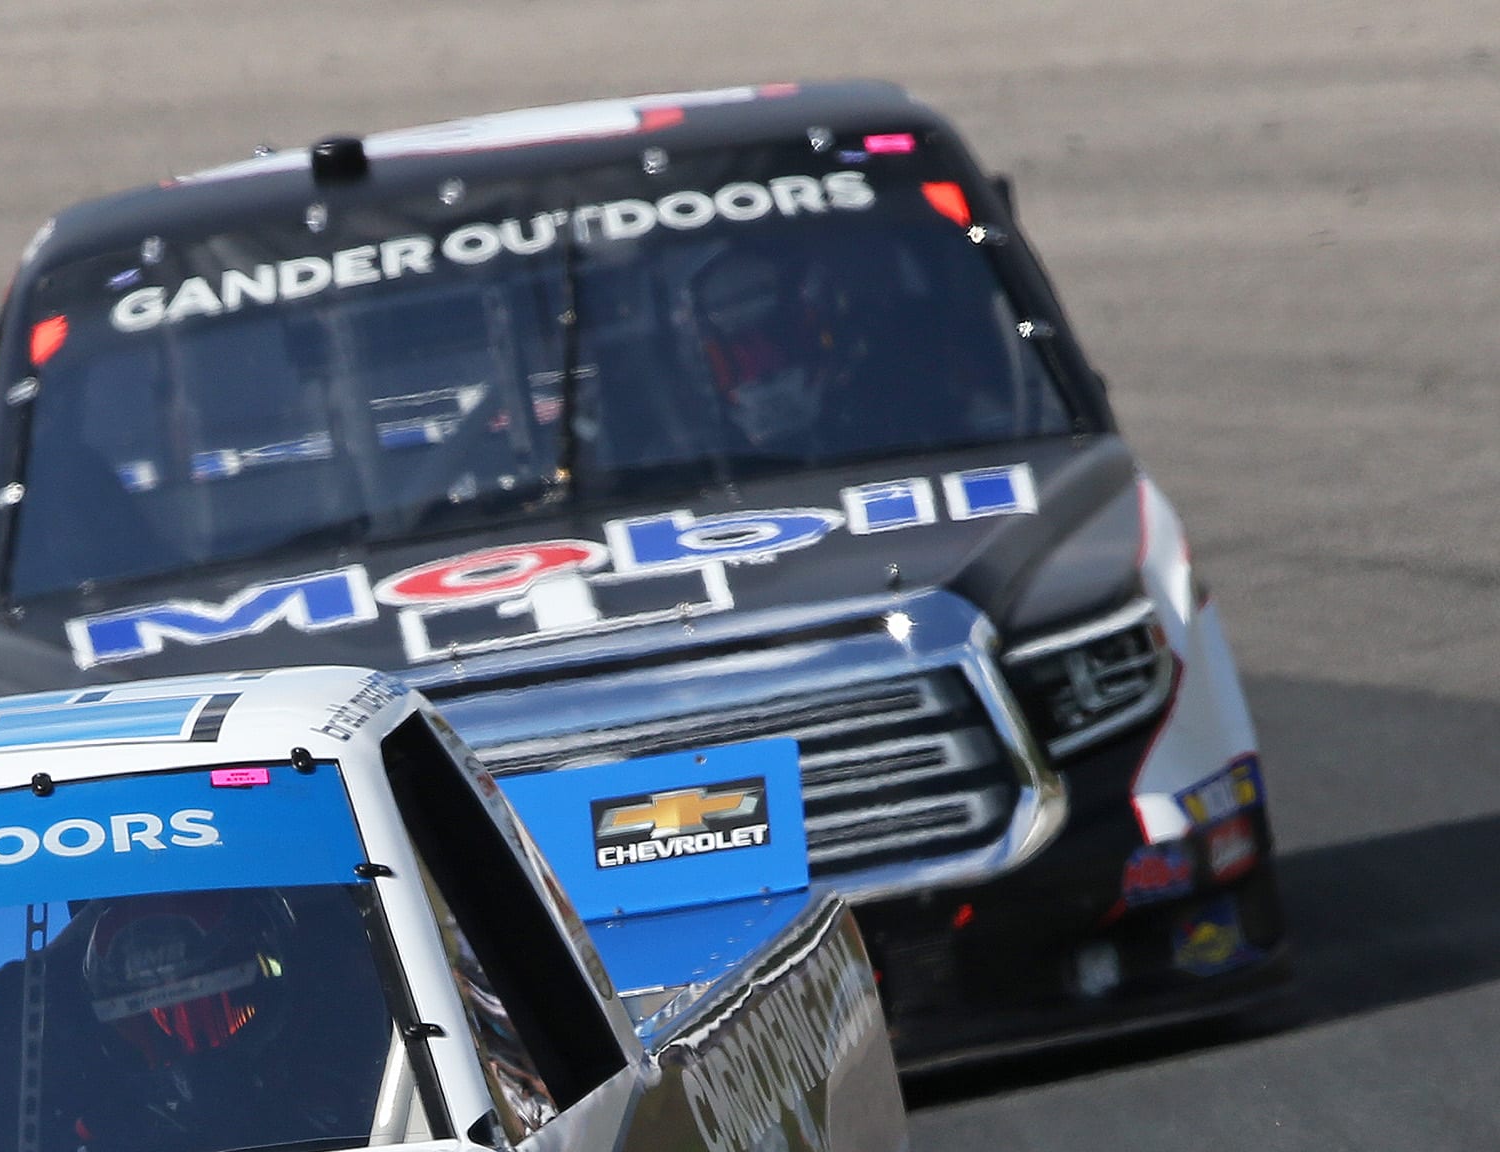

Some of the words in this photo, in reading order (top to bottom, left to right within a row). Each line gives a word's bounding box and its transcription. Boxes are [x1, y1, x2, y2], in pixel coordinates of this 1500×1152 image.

[109, 234, 436, 333] GANDER
[441, 171, 875, 265] OUTDOORS
[65, 462, 1038, 671] Mobil
[598, 823, 769, 868] CHEVROLET
